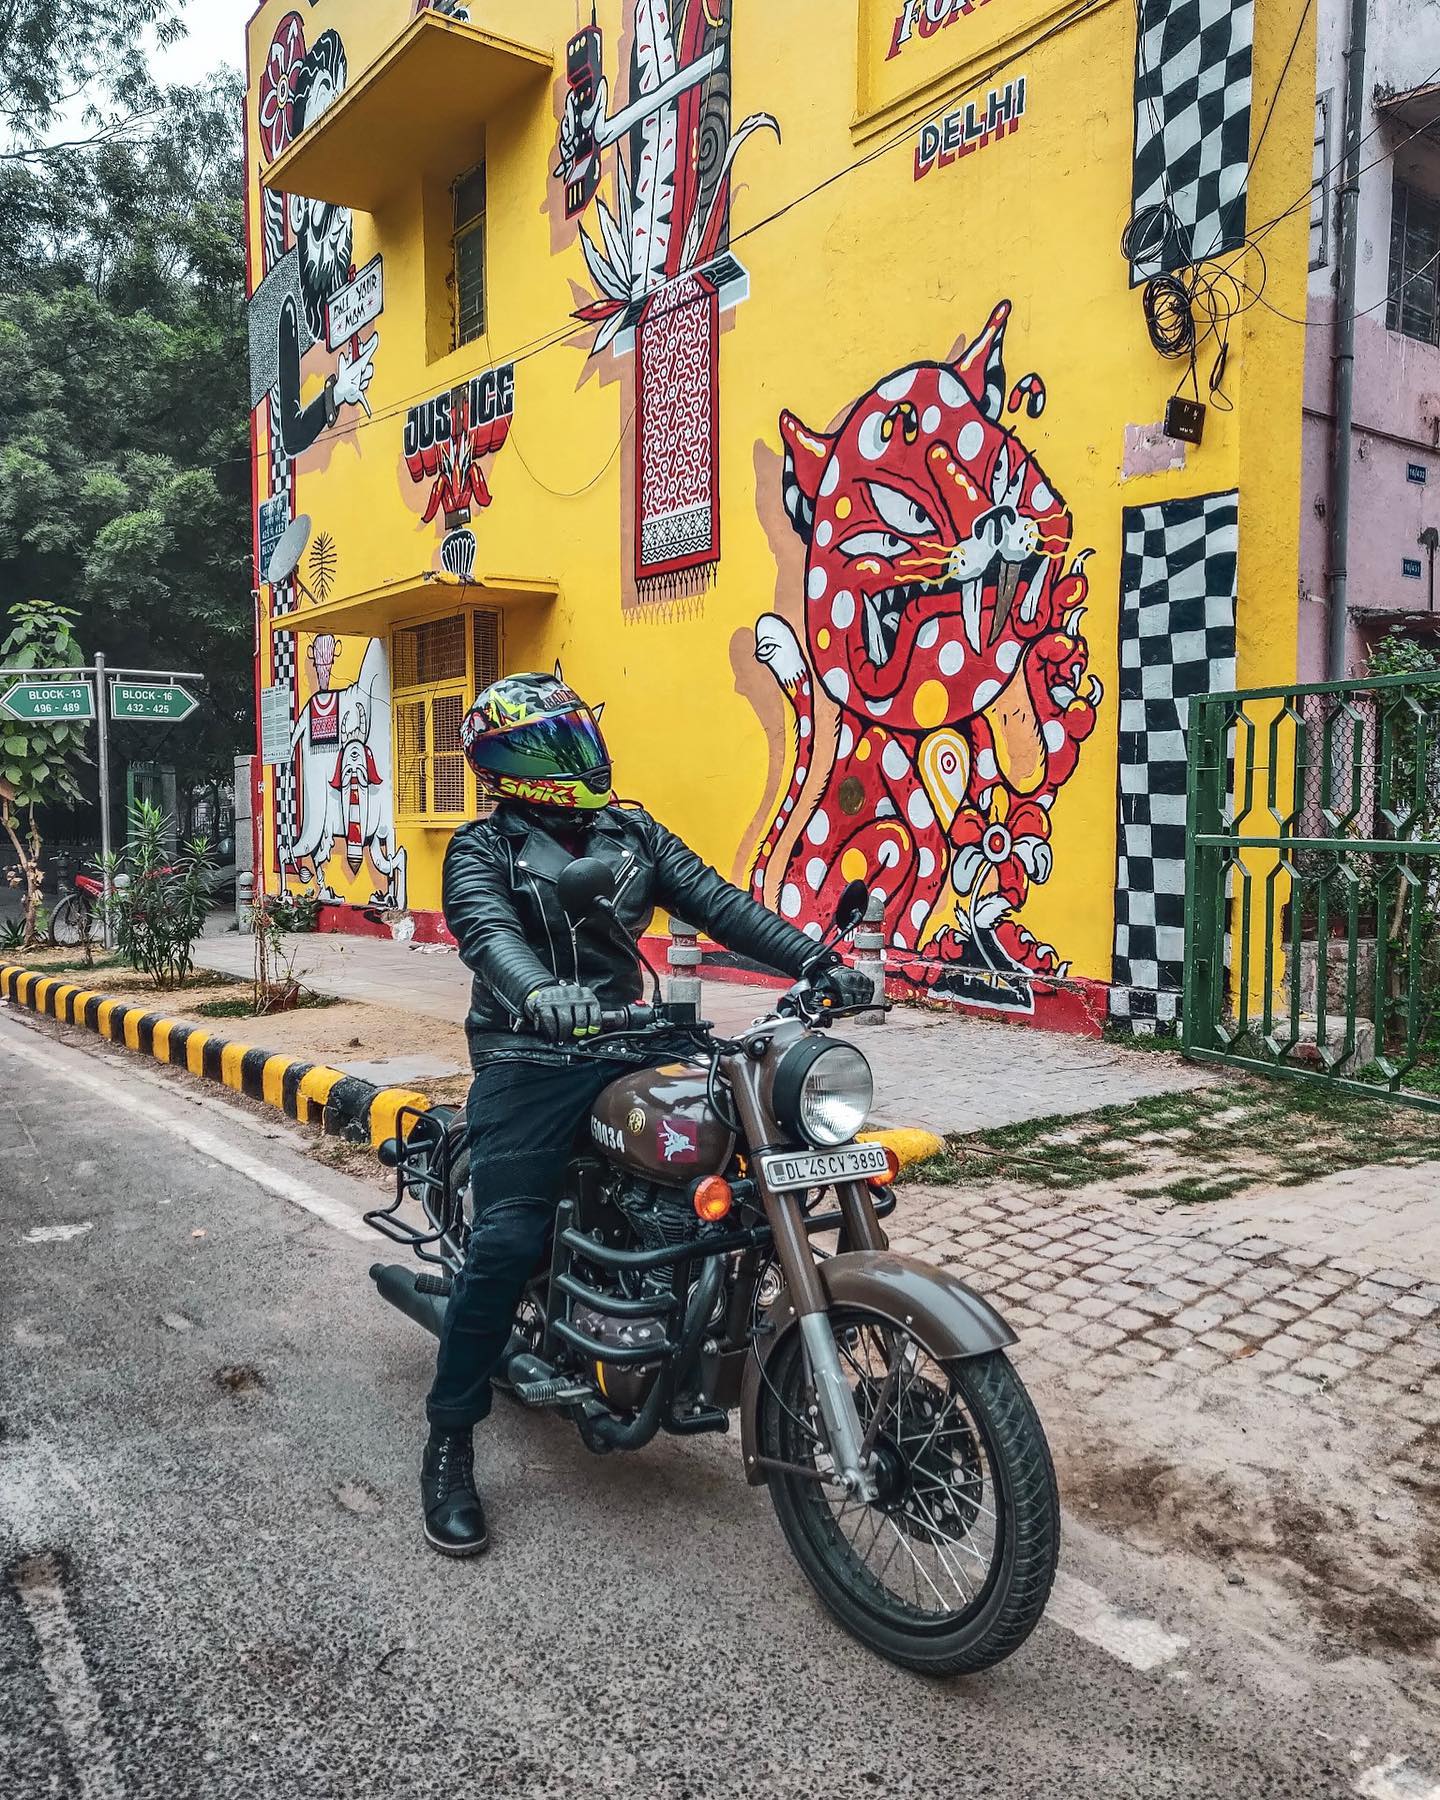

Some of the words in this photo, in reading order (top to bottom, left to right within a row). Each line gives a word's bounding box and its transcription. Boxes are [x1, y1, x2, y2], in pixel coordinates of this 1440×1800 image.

[914, 76, 1027, 178] DELHI
[356, 273, 377, 302] YOUR
[344, 302, 366, 332] MOM
[403, 361, 515, 462] JUSTICE
[28, 690, 65, 700] BLOCK
[70, 689, 82, 698] 13
[33, 703, 52, 712] 496
[62, 703, 80, 712] 489
[122, 690, 155, 700] BLOCK
[163, 692, 173, 701] 16
[126, 703, 144, 712] 432
[152, 704, 169, 713] 425
[499, 777, 571, 804] SMK
[785, 1162, 806, 1180] DL
[850, 1151, 885, 1170] 3890
